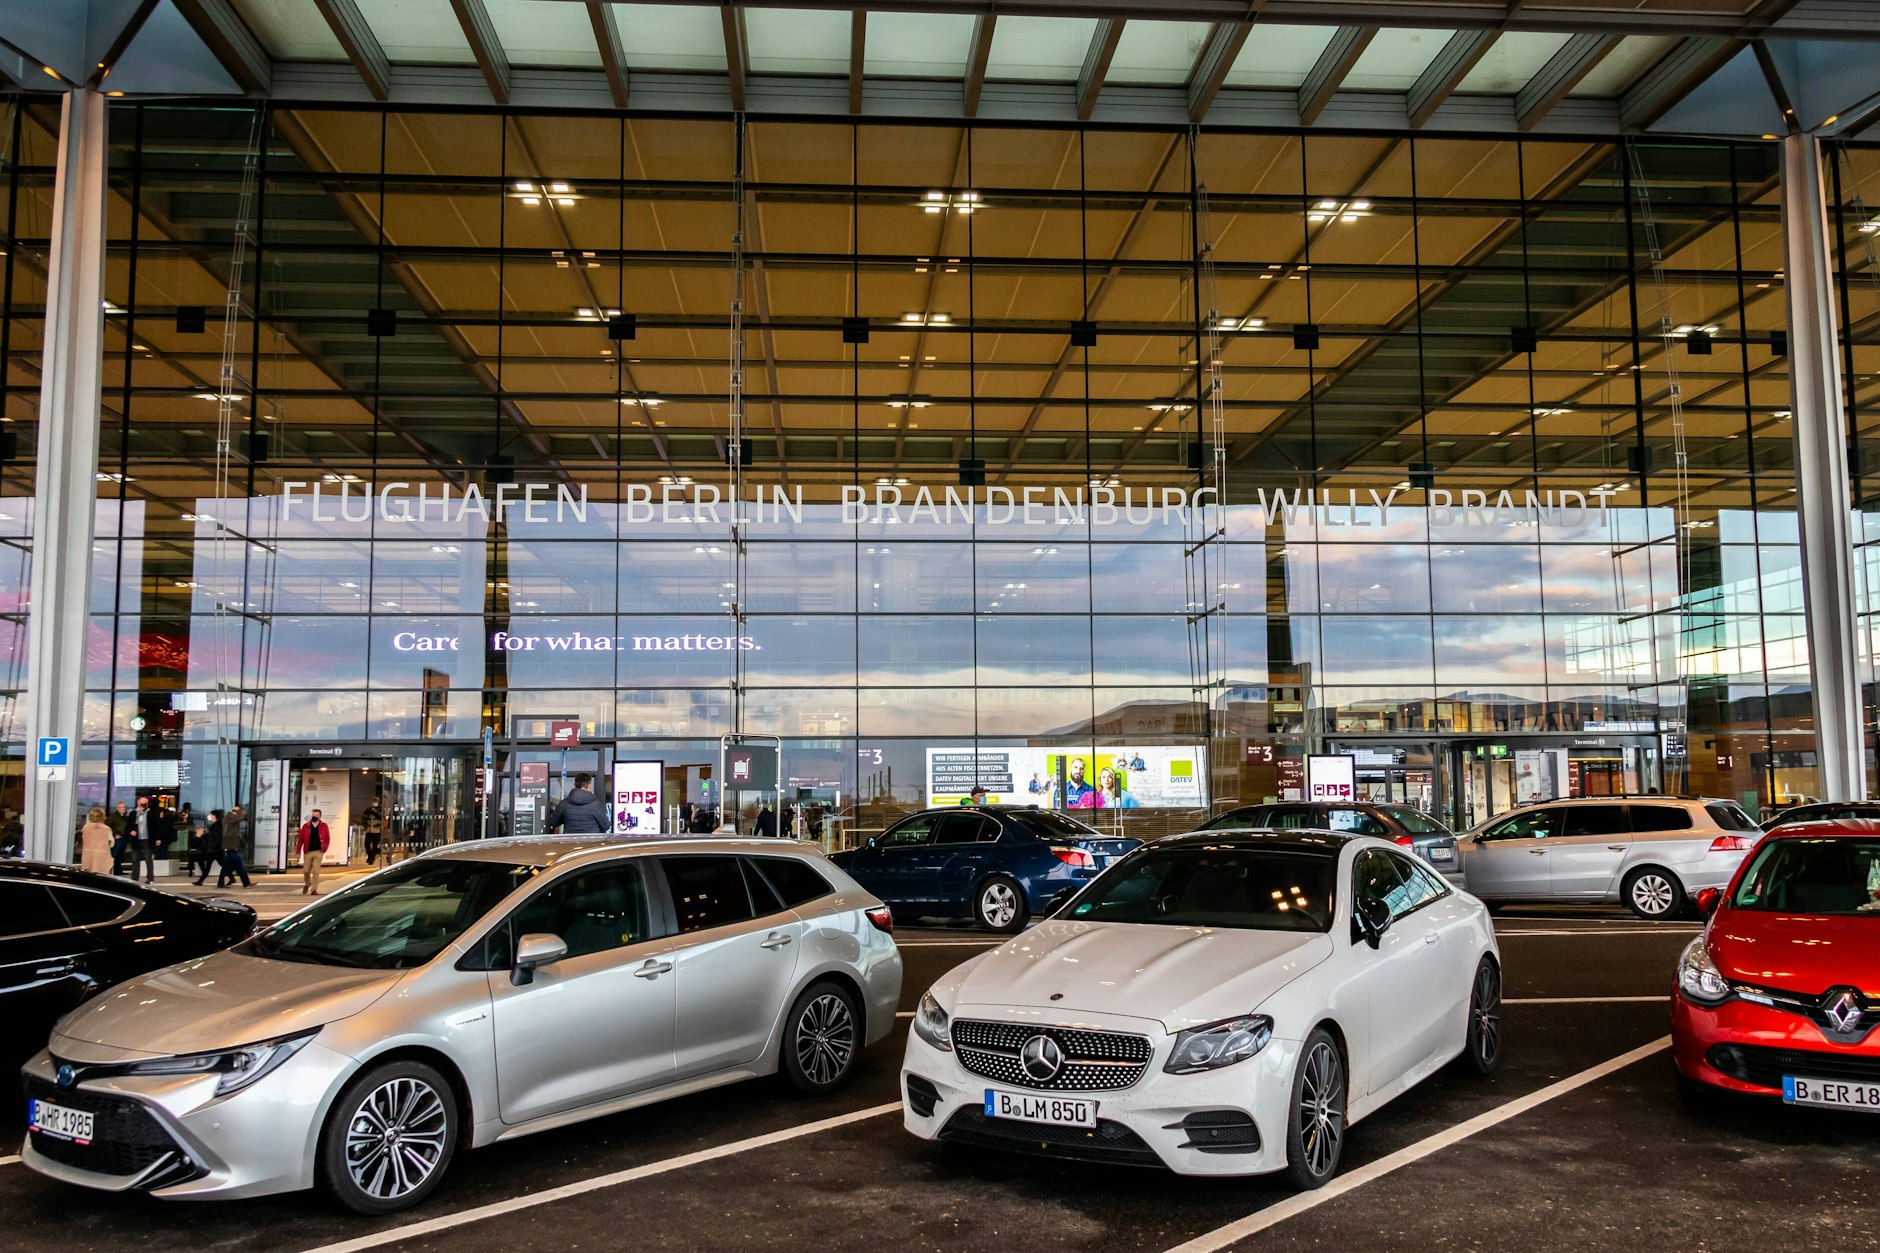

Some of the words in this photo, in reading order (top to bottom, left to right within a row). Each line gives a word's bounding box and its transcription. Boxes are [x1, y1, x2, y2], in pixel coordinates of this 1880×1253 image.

[283, 481, 587, 523] FLUGHAFEN
[627, 483, 802, 524] BERLIN
[841, 485, 1219, 526] BRANDENBURG
[1257, 487, 1398, 527] WILLY
[1429, 489, 1616, 528] BRANDT
[494, 631, 540, 651] for
[632, 633, 762, 651] matters.
[44, 741, 62, 763] P
[872, 749, 883, 765] 3
[1262, 746, 1273, 762] 3
[1795, 1081, 1809, 1099] B
[1823, 1084, 1850, 1104] ER
[35, 1103, 41, 1123] B
[46, 1107, 59, 1129] HR
[62, 1111, 92, 1136] 1985
[1001, 1095, 1012, 1114] B
[1023, 1098, 1047, 1120] LM
[1051, 1101, 1087, 1123] 850
